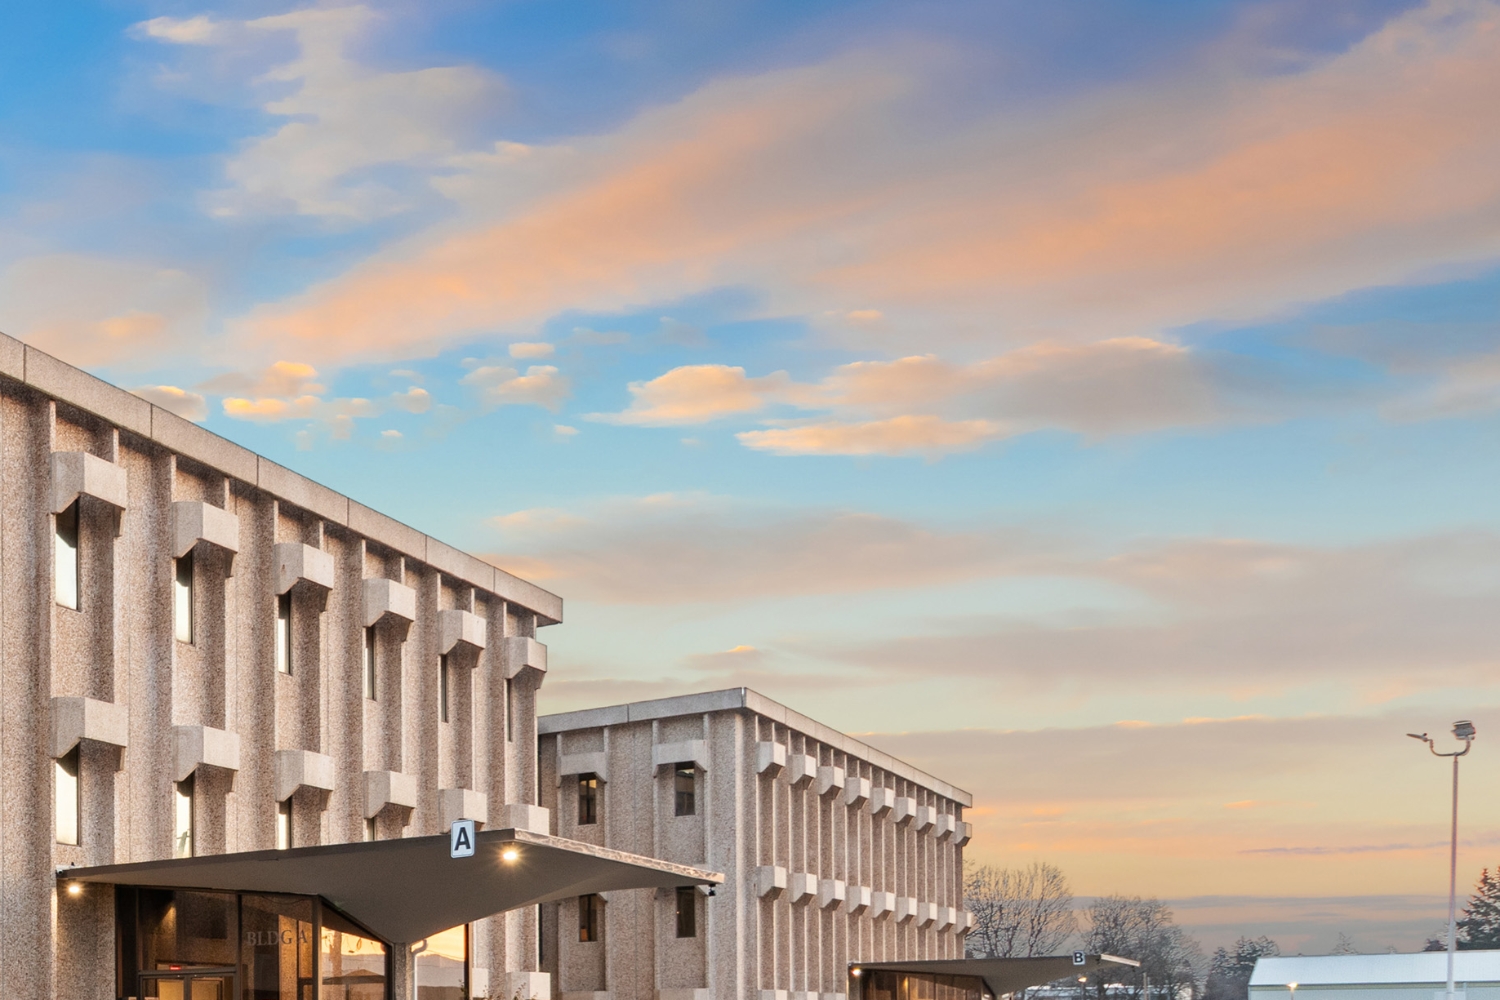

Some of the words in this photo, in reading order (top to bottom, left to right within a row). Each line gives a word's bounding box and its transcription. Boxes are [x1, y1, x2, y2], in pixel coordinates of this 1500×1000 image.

[454, 826, 471, 851] A
[246, 929, 293, 946] BLDG
[297, 929, 308, 944] A
[1074, 952, 1083, 963] B
